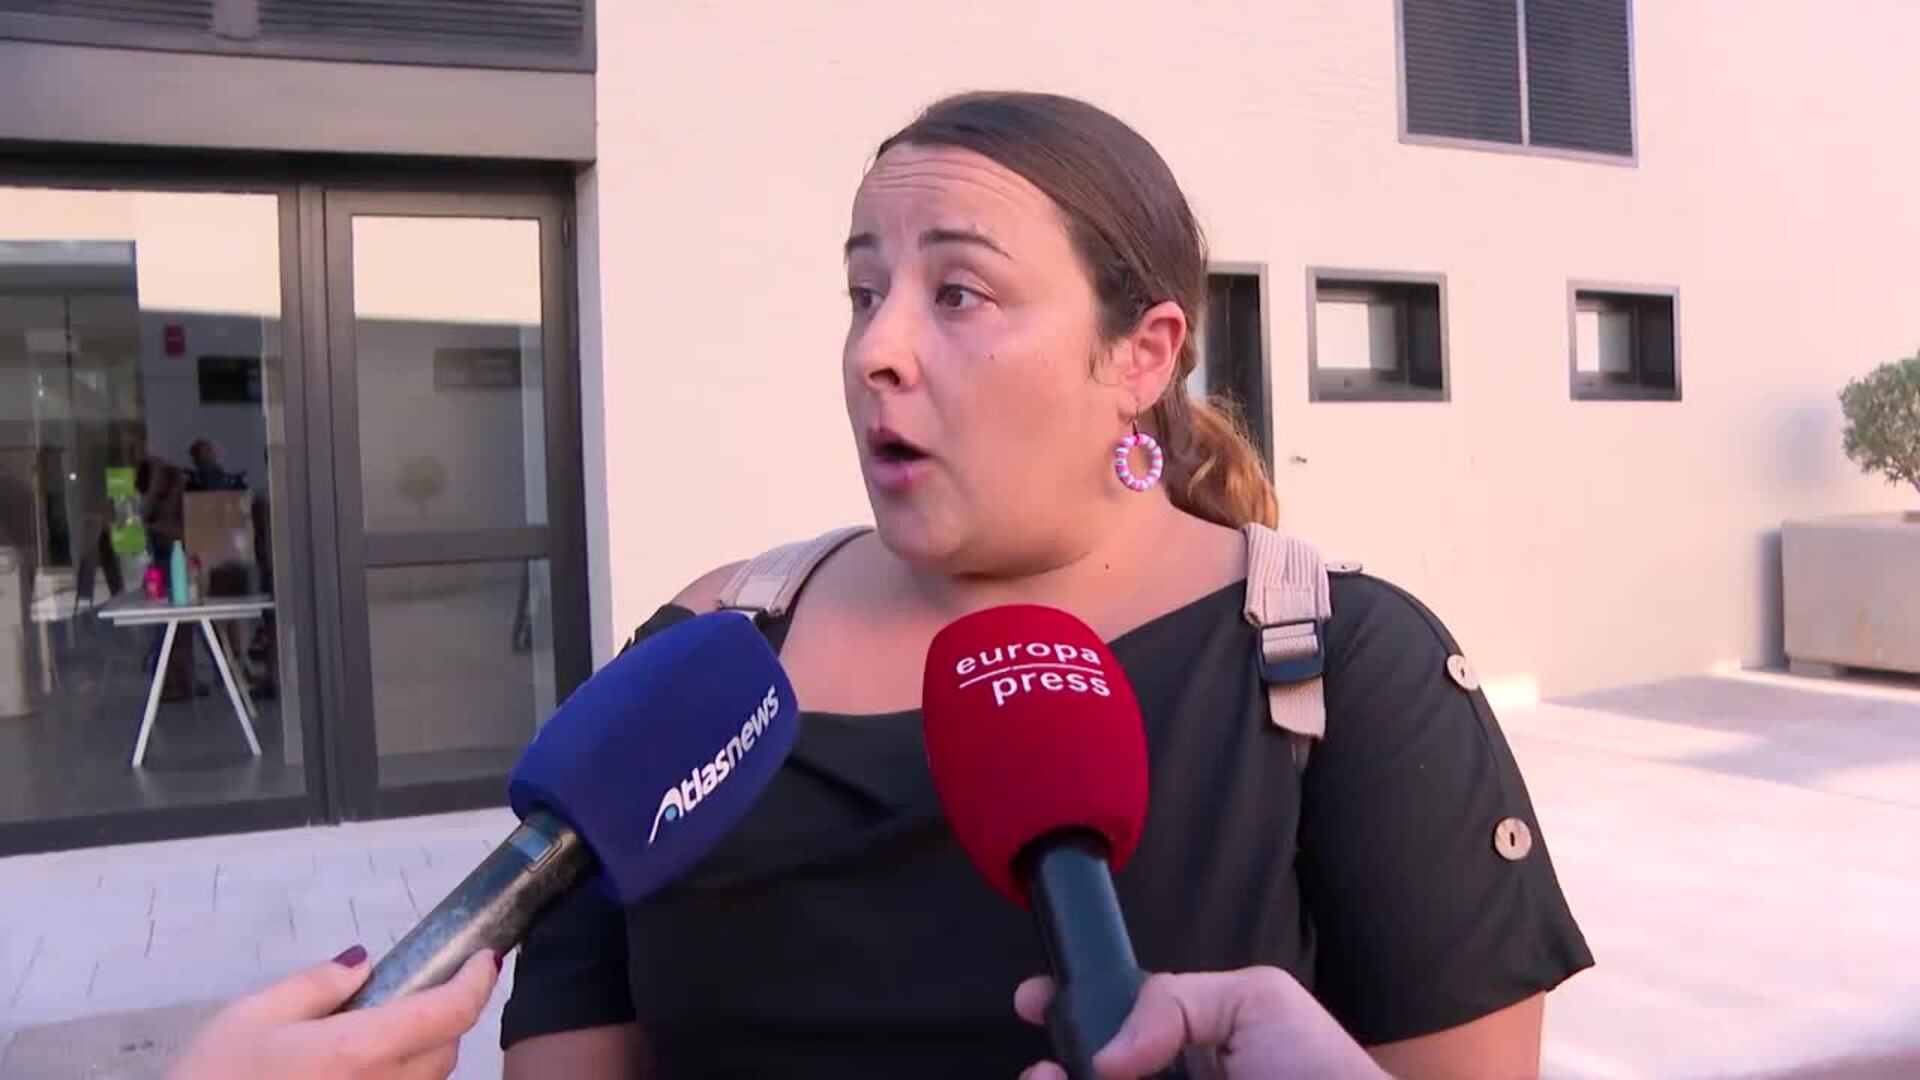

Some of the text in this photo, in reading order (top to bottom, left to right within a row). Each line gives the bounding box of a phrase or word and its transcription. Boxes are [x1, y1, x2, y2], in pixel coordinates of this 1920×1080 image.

[956, 642, 1101, 674] europa
[992, 672, 1111, 706] press
[649, 684, 780, 844] Atlasnews
